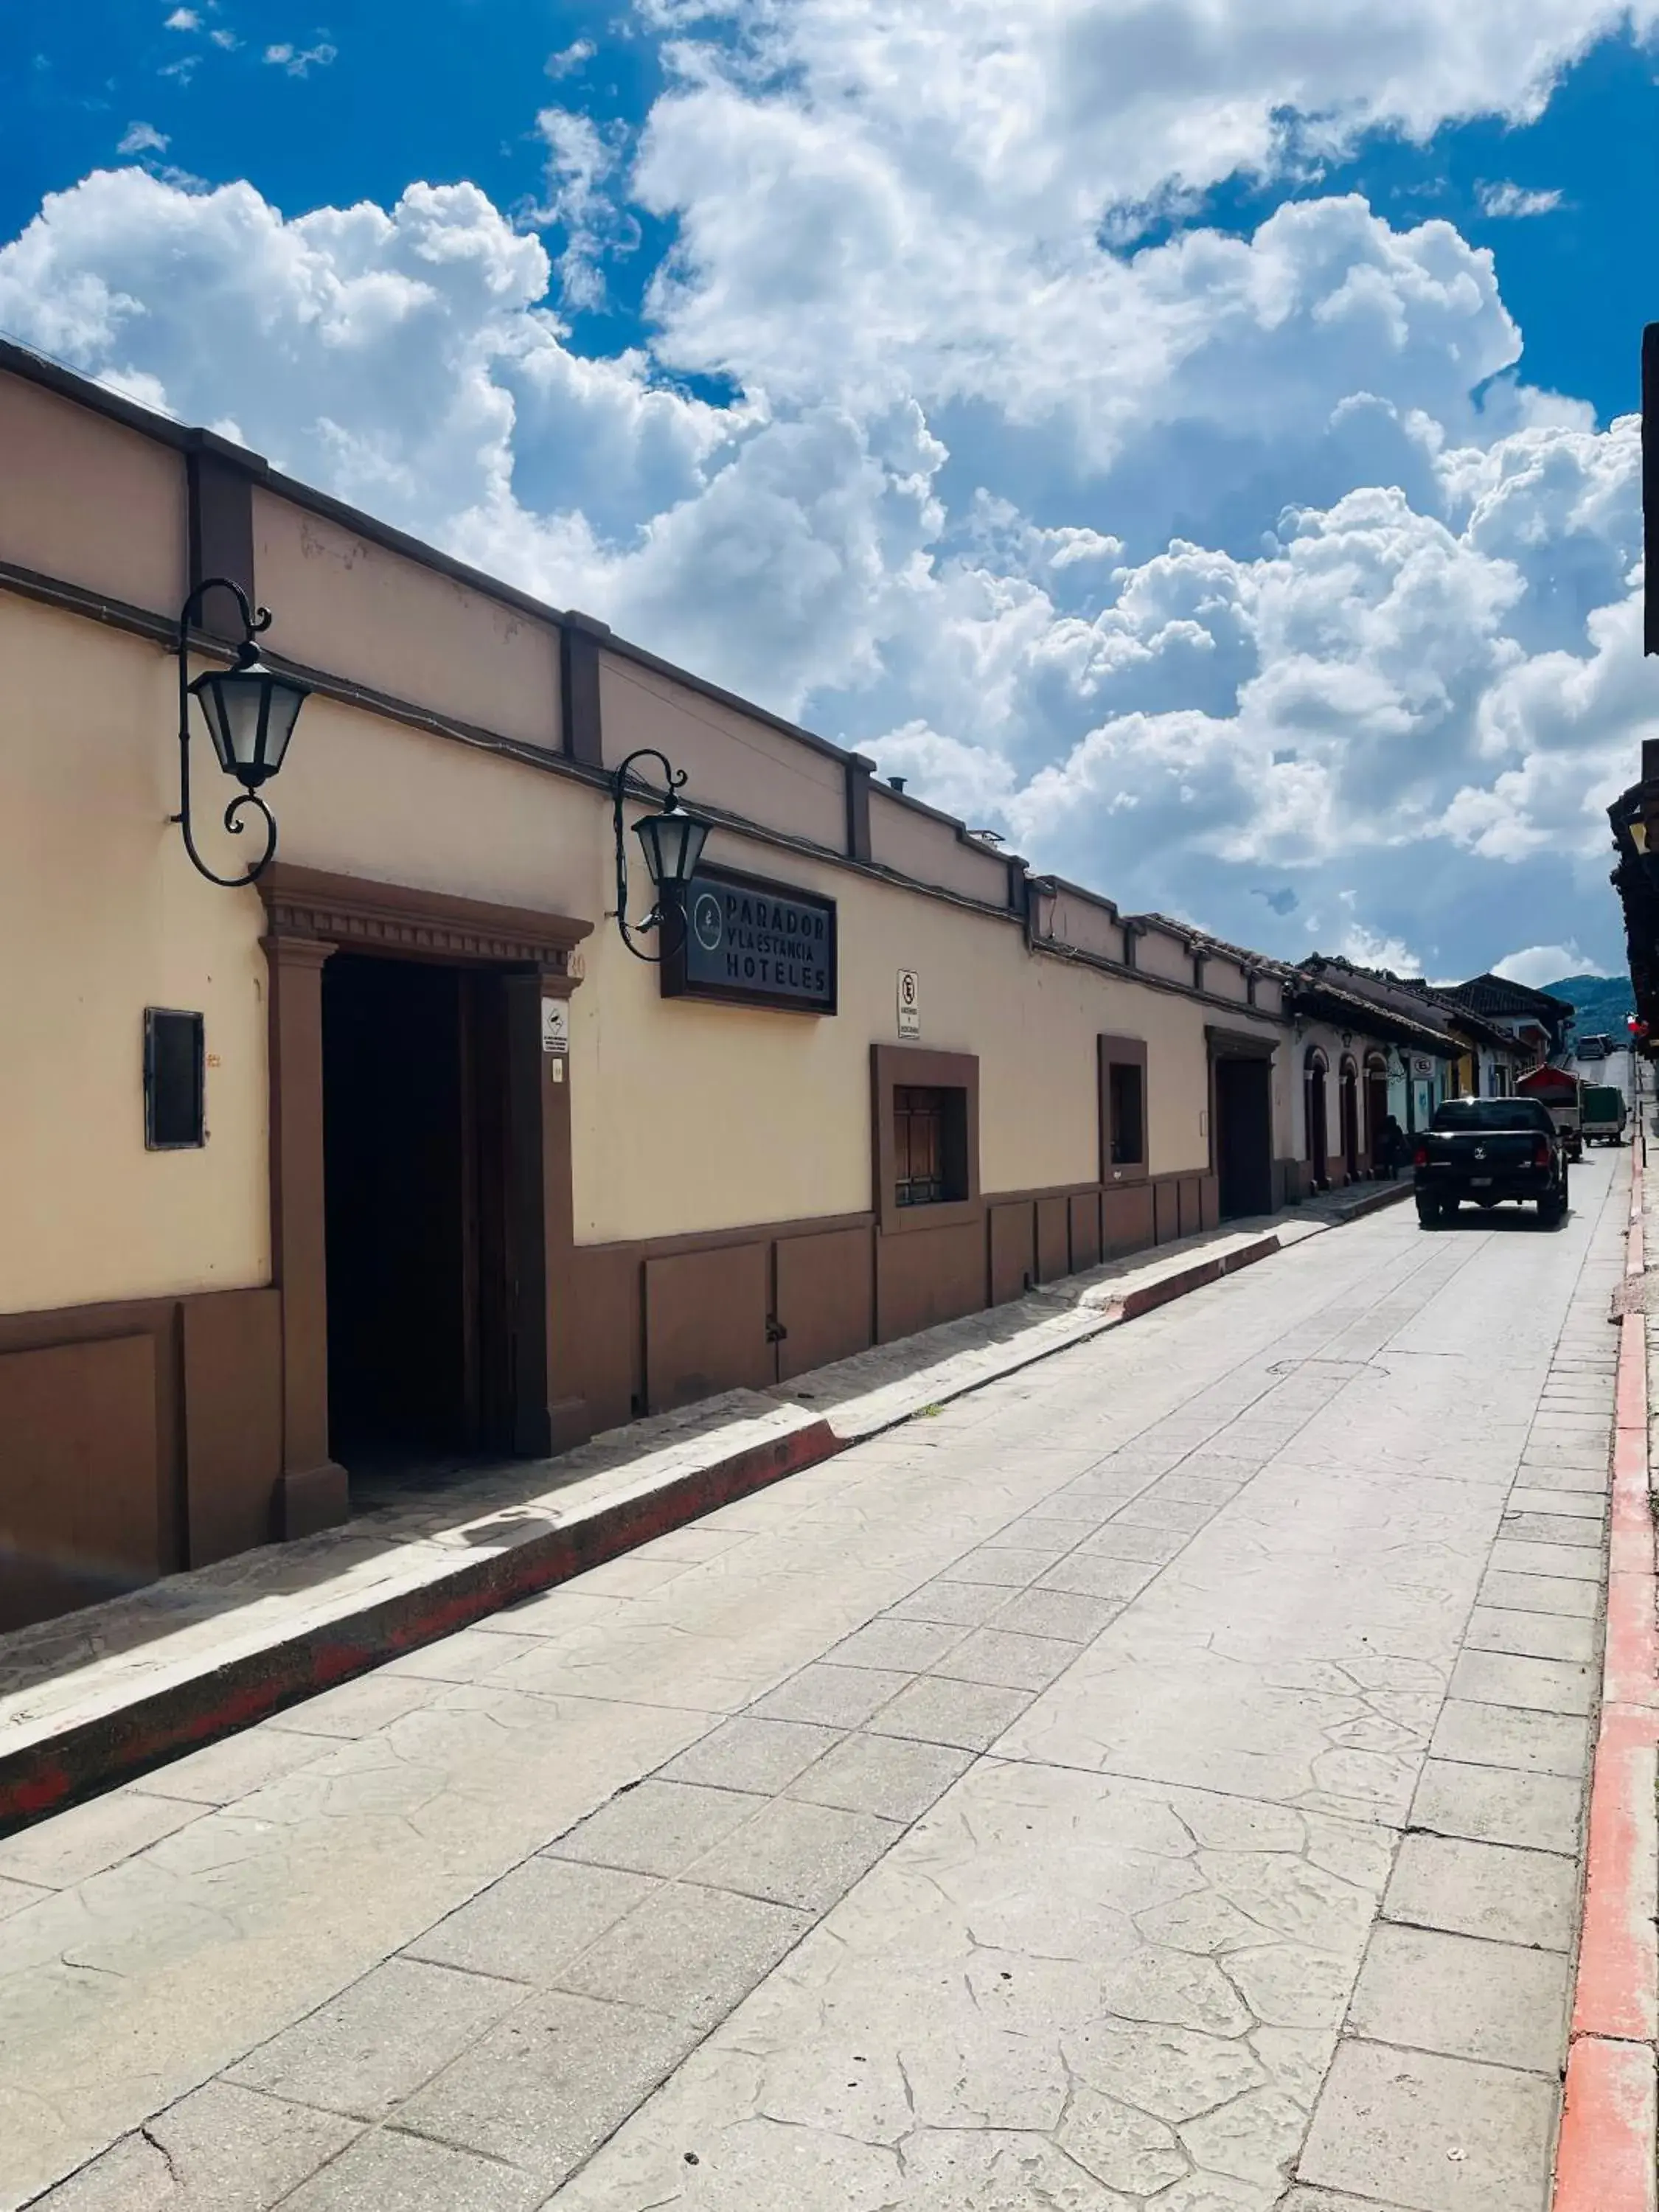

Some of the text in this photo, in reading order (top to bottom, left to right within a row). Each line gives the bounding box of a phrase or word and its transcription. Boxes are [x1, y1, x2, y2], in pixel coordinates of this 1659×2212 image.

[726, 894, 824, 940] PARADOR
[757, 933, 814, 962] ESTANCIA
[726, 953, 825, 992] HOTELES
